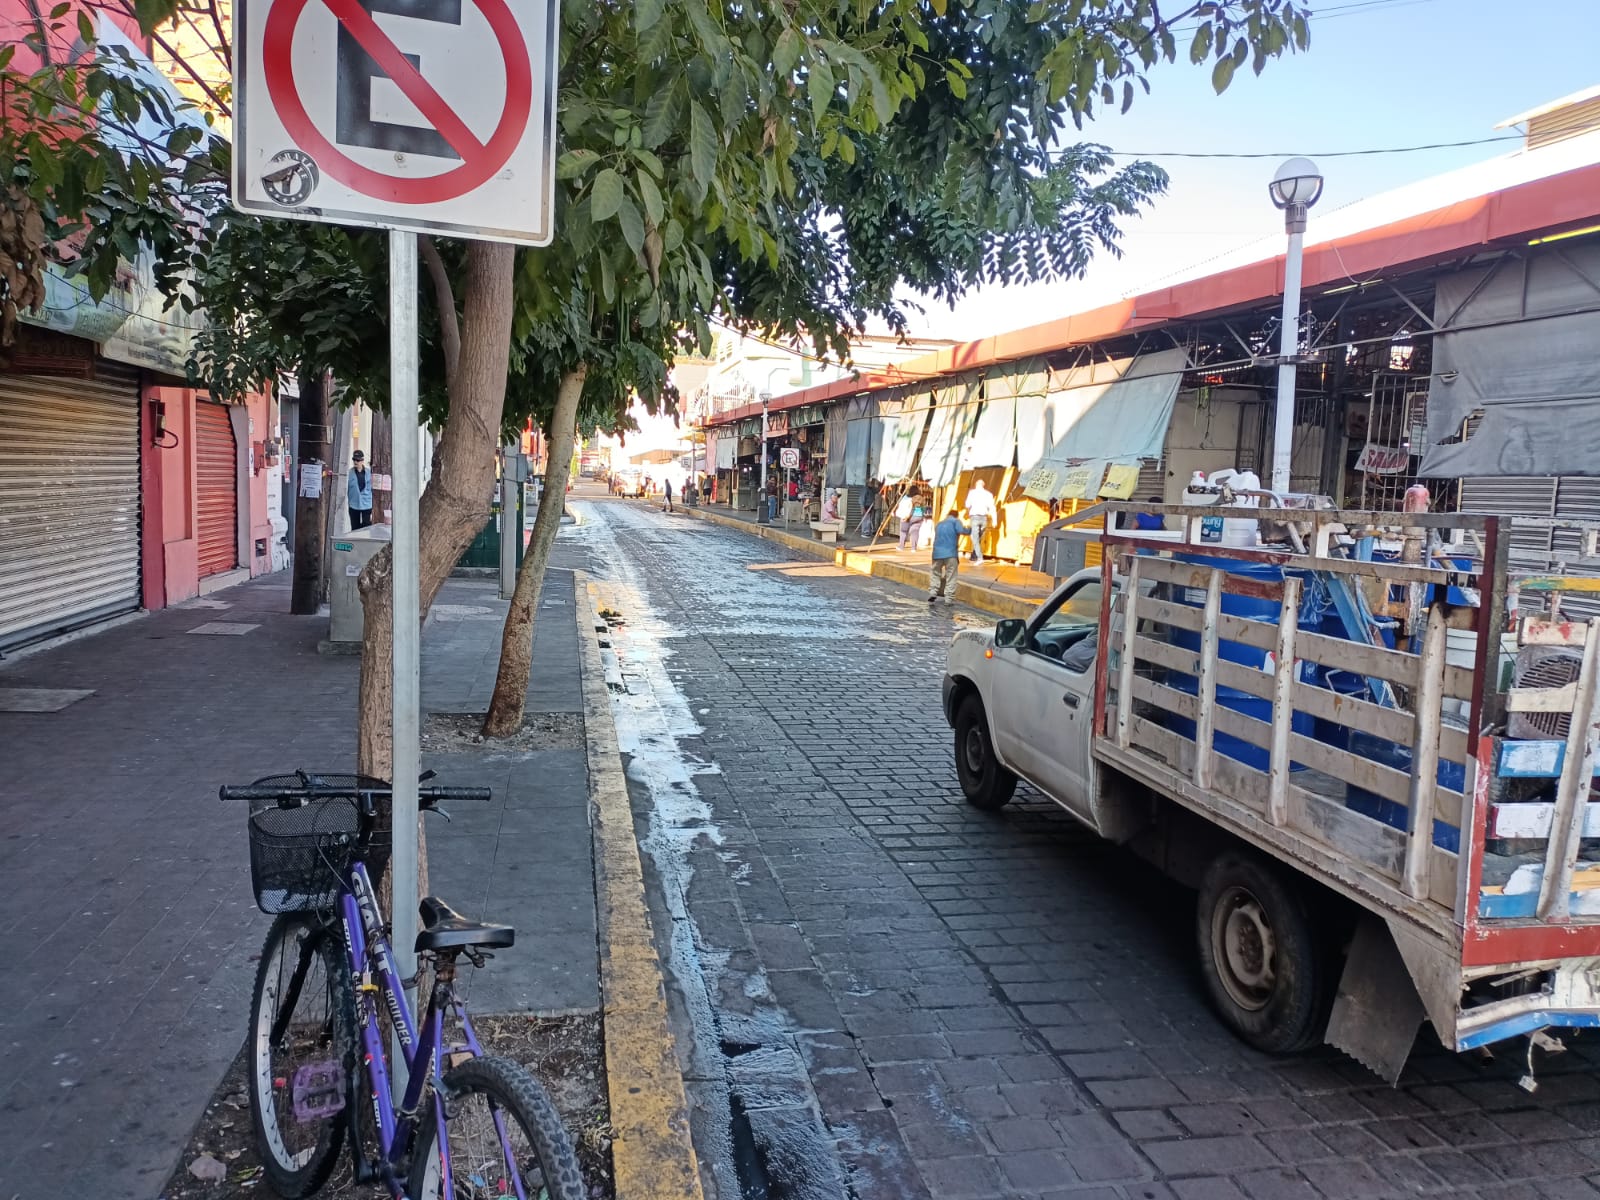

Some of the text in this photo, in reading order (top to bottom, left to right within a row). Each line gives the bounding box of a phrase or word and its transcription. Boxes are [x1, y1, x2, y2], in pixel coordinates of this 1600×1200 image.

[342, 917, 353, 953] SCOTT
[384, 989, 412, 1046] BOULDER
[371, 1099, 382, 1129] SCOTT
